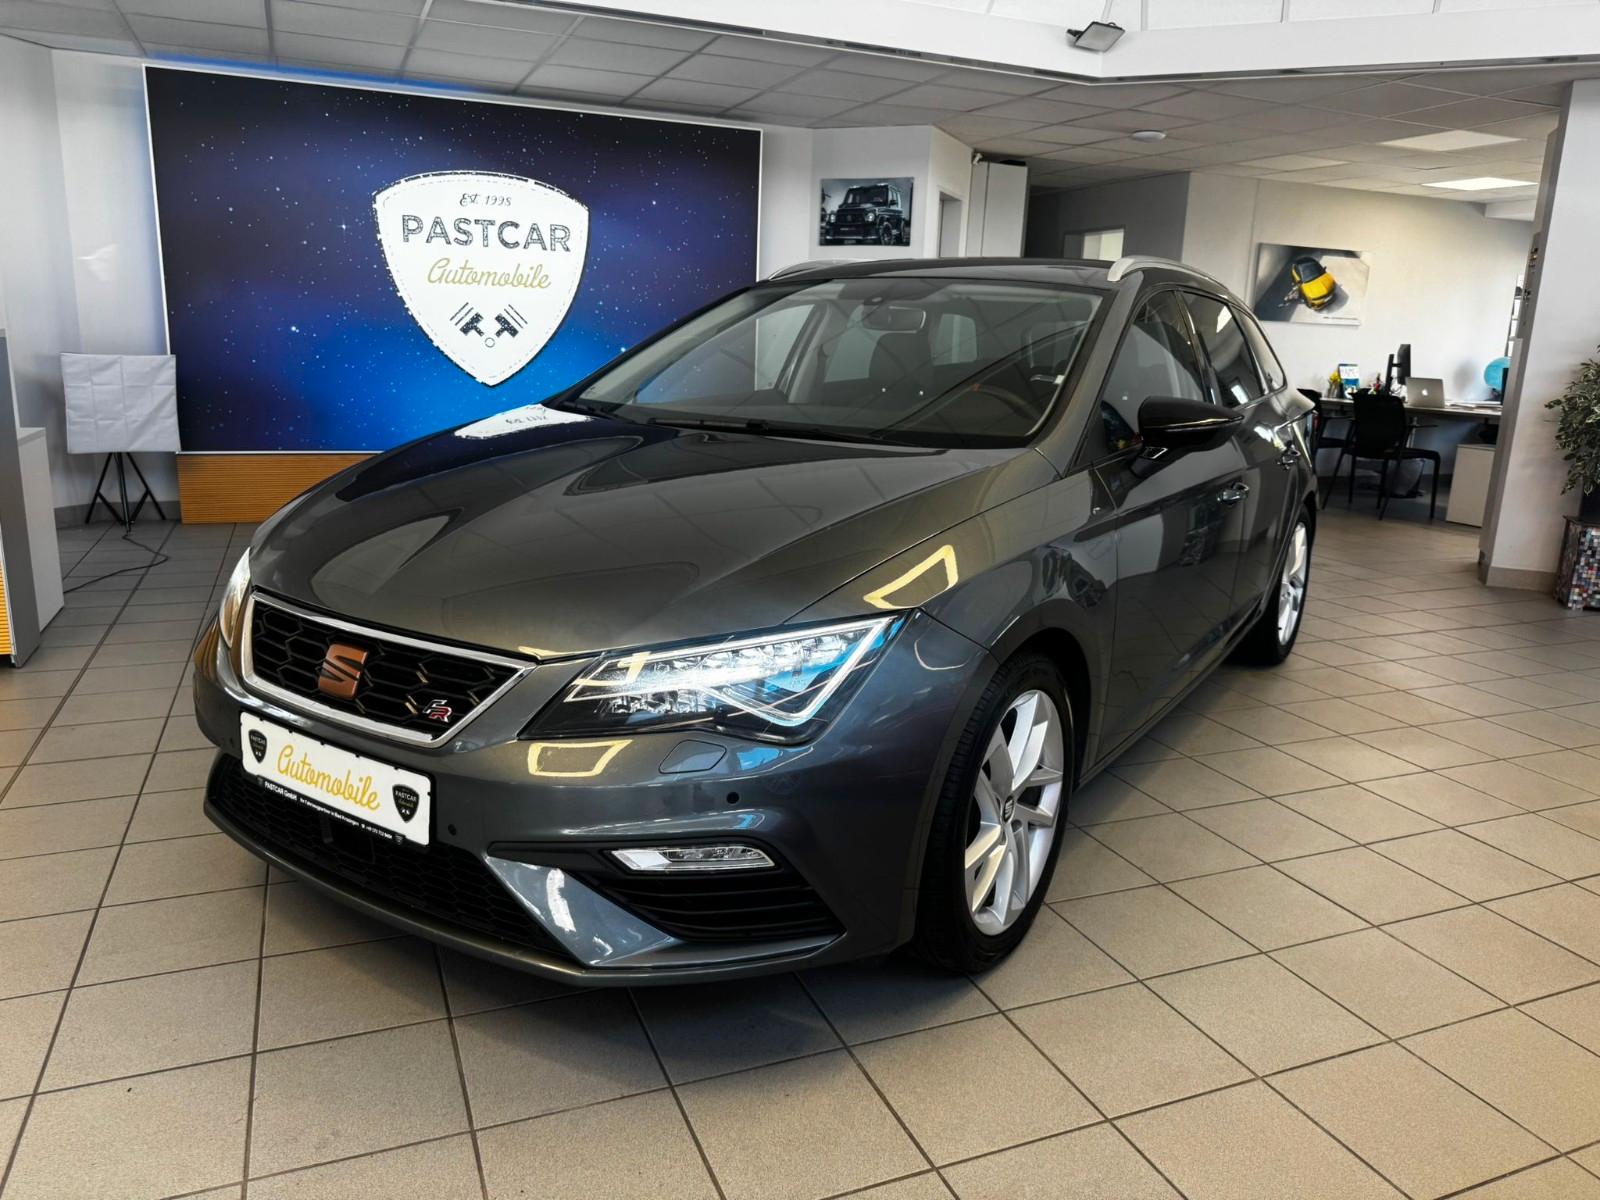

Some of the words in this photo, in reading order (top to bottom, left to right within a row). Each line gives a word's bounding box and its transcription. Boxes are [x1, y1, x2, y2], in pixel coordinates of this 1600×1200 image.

[402, 214, 571, 253] PASTCAR
[427, 257, 552, 289] Automobile
[276, 744, 381, 812] Automobile
